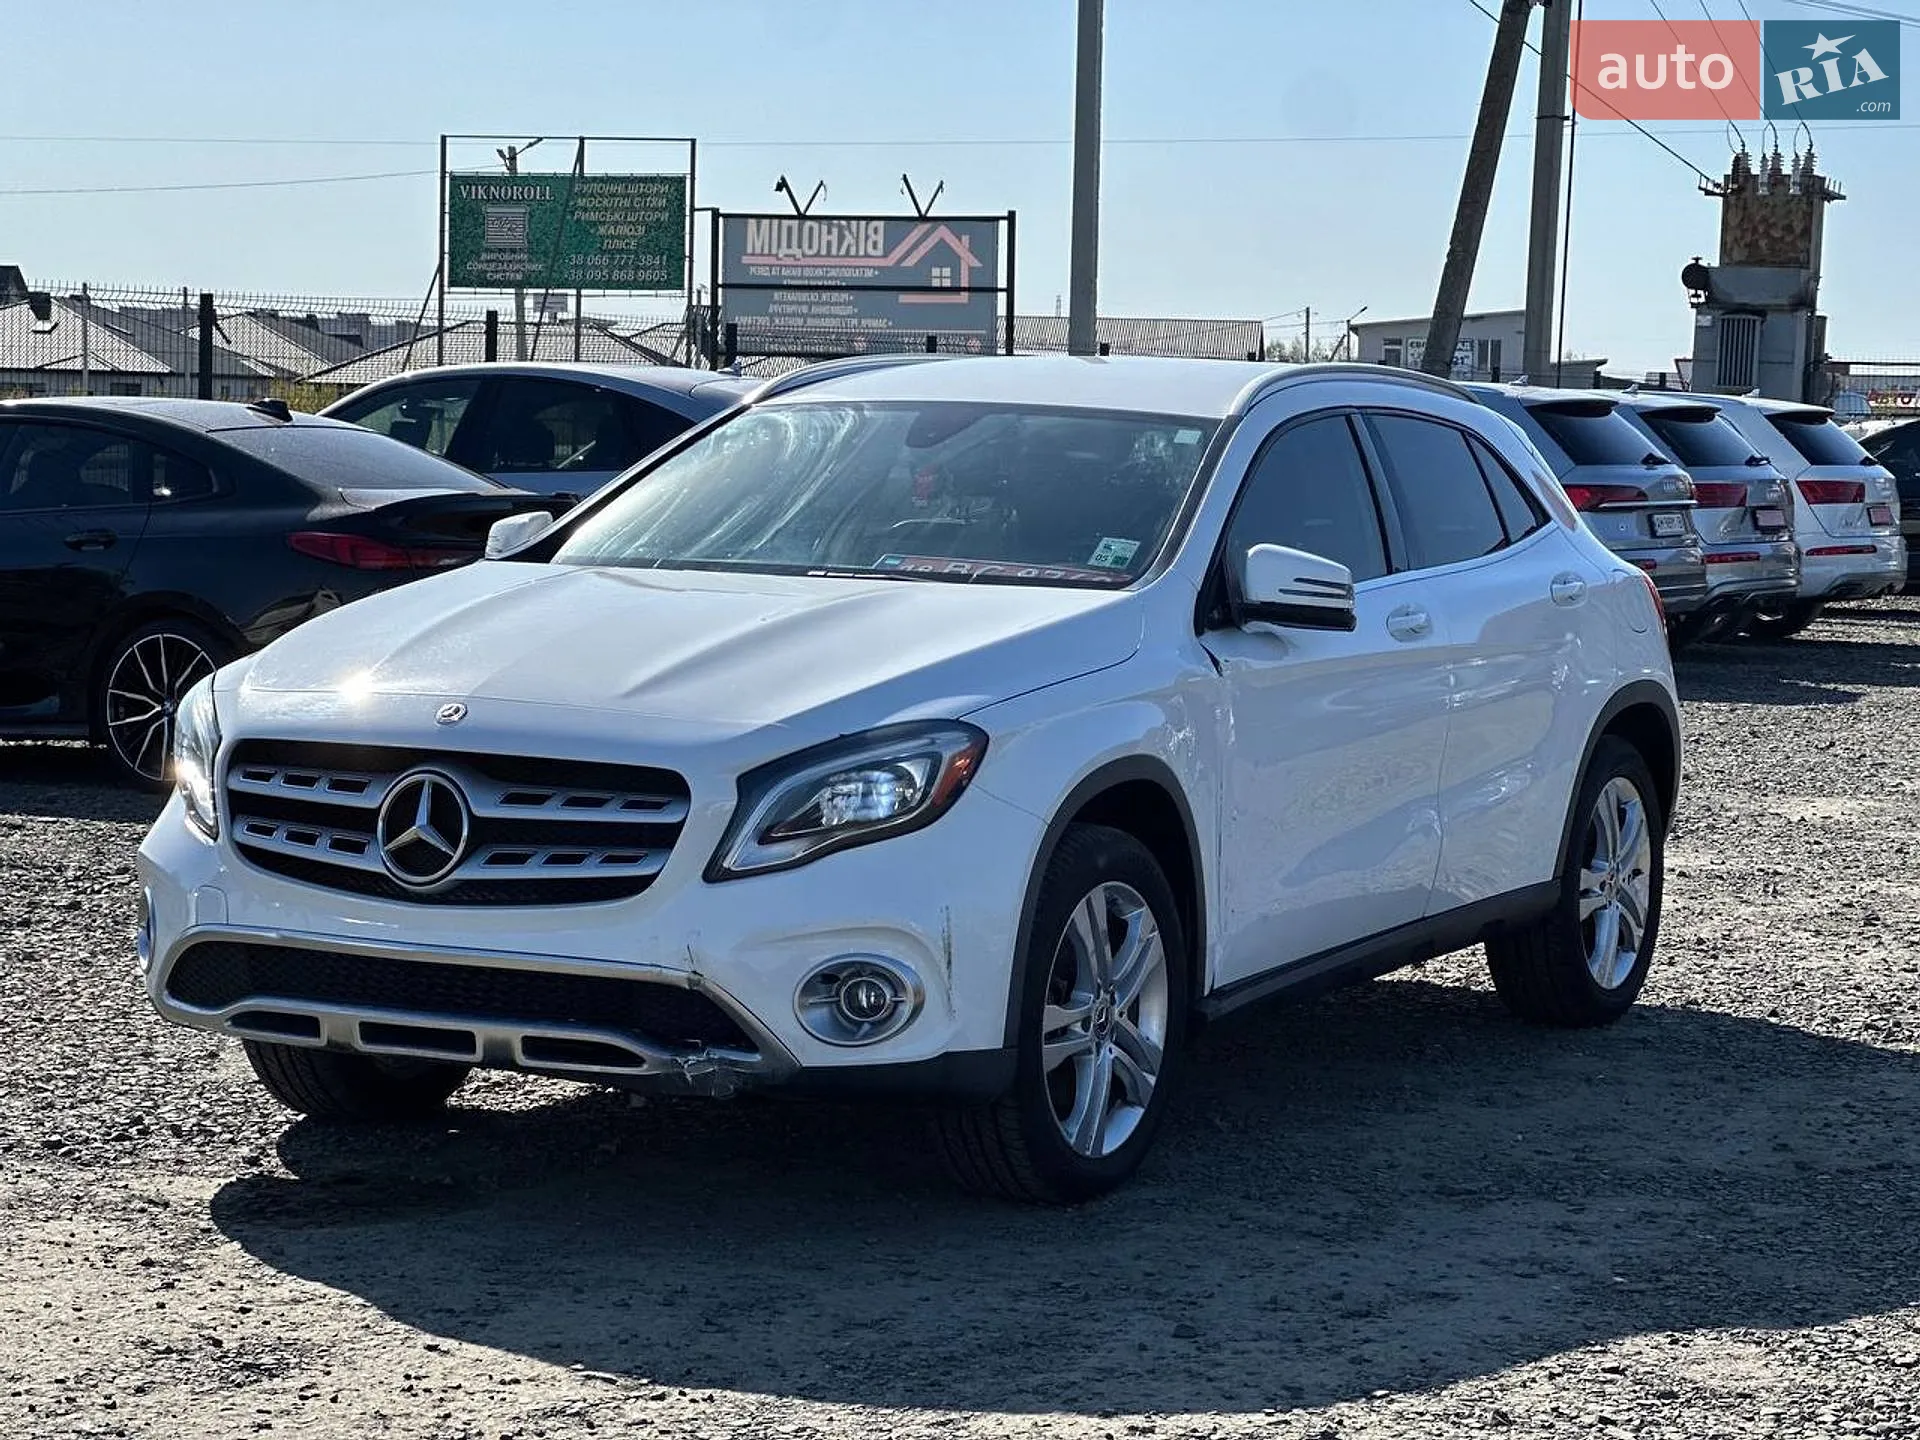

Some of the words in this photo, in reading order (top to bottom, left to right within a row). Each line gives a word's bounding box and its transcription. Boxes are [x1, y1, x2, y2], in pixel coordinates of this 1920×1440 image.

[460, 185, 555, 200] VIKNOROLL
[627, 183, 669, 194] ШТОРИ
[633, 198, 667, 208] СІТКИ
[573, 211, 624, 221] РИМСЬКІ
[627, 211, 669, 221] ШТОРИ
[599, 225, 646, 235] ЖАЛЮЗІ
[613, 255, 635, 265] 777
[612, 269, 635, 280] 868
[638, 269, 668, 280] 9605
